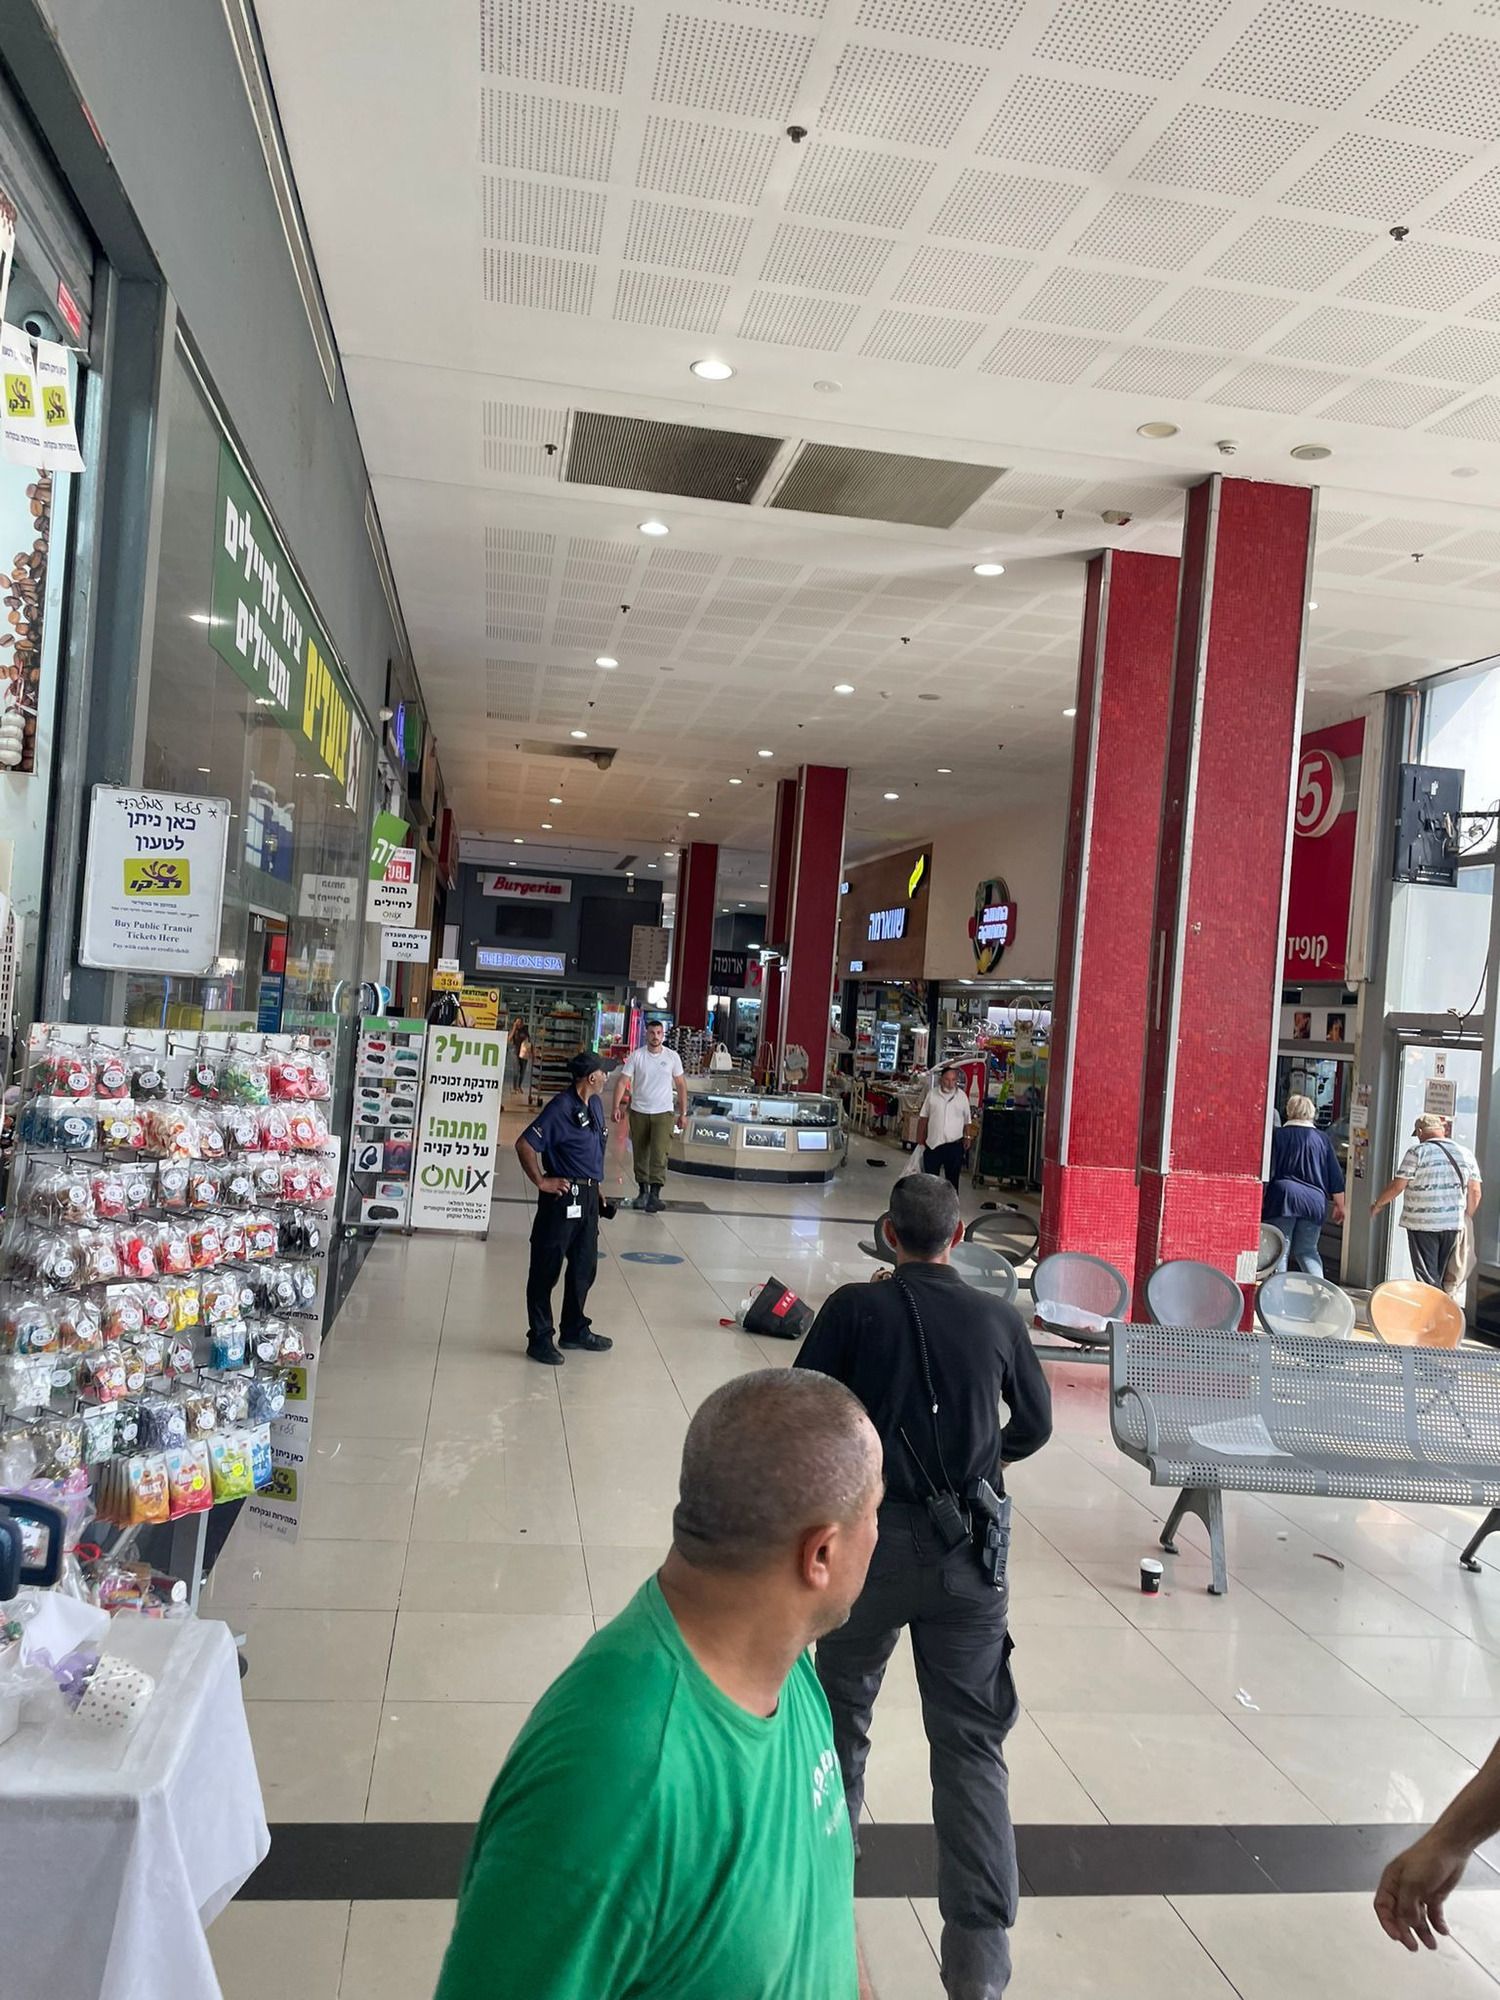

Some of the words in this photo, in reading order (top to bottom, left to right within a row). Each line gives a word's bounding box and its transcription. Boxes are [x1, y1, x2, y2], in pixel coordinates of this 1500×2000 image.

[224, 495, 280, 624] לחיילים
[281, 594, 303, 665] ציוד
[235, 597, 290, 712] ומטיילים
[303, 636, 349, 787] צועדים
[1297, 760, 1323, 827] 5
[127, 812, 161, 828] ניתן
[166, 816, 196, 831] כאן
[135, 835, 184, 851] לטעון
[387, 864, 410, 880] JBL
[130, 879, 182, 892] רב-קו
[381, 885, 407, 894] הנחה
[493, 876, 562, 895] Burgerim
[374, 899, 412, 909] לחיילים
[114, 919, 130, 930] Buy
[134, 921, 160, 931] Public
[162, 923, 193, 933] Transit
[868, 907, 906, 941] שווארמה
[127, 931, 157, 941] Tickets
[159, 934, 180, 943] Here
[392, 941, 419, 949] בחינם
[1288, 935, 1328, 967] קופיז
[480, 951, 503, 966] THE
[503, 953, 544, 969] PHONE
[544, 957, 565, 970] SPA
[714, 956, 744, 975] ארומה
[435, 1033, 499, 1067] חייל?
[1436, 1064, 1445, 1074] 10
[429, 1073, 462, 1087] זכוכית
[464, 1076, 499, 1090] מדבקת
[442, 1090, 484, 1104] לפלאפון
[428, 1116, 487, 1140] מתנה!
[696, 1128, 714, 1138] NOVA
[749, 1133, 768, 1143] NOVA
[423, 1141, 452, 1157] קניה
[456, 1142, 470, 1157] כל
[475, 1144, 489, 1157] על
[285, 1413, 309, 1423] במהירו
[275, 1449, 290, 1458] ניתן
[291, 1454, 304, 1462] כאן
[249, 1506, 271, 1517] ובקלות
[272, 1512, 297, 1526] במהירות
